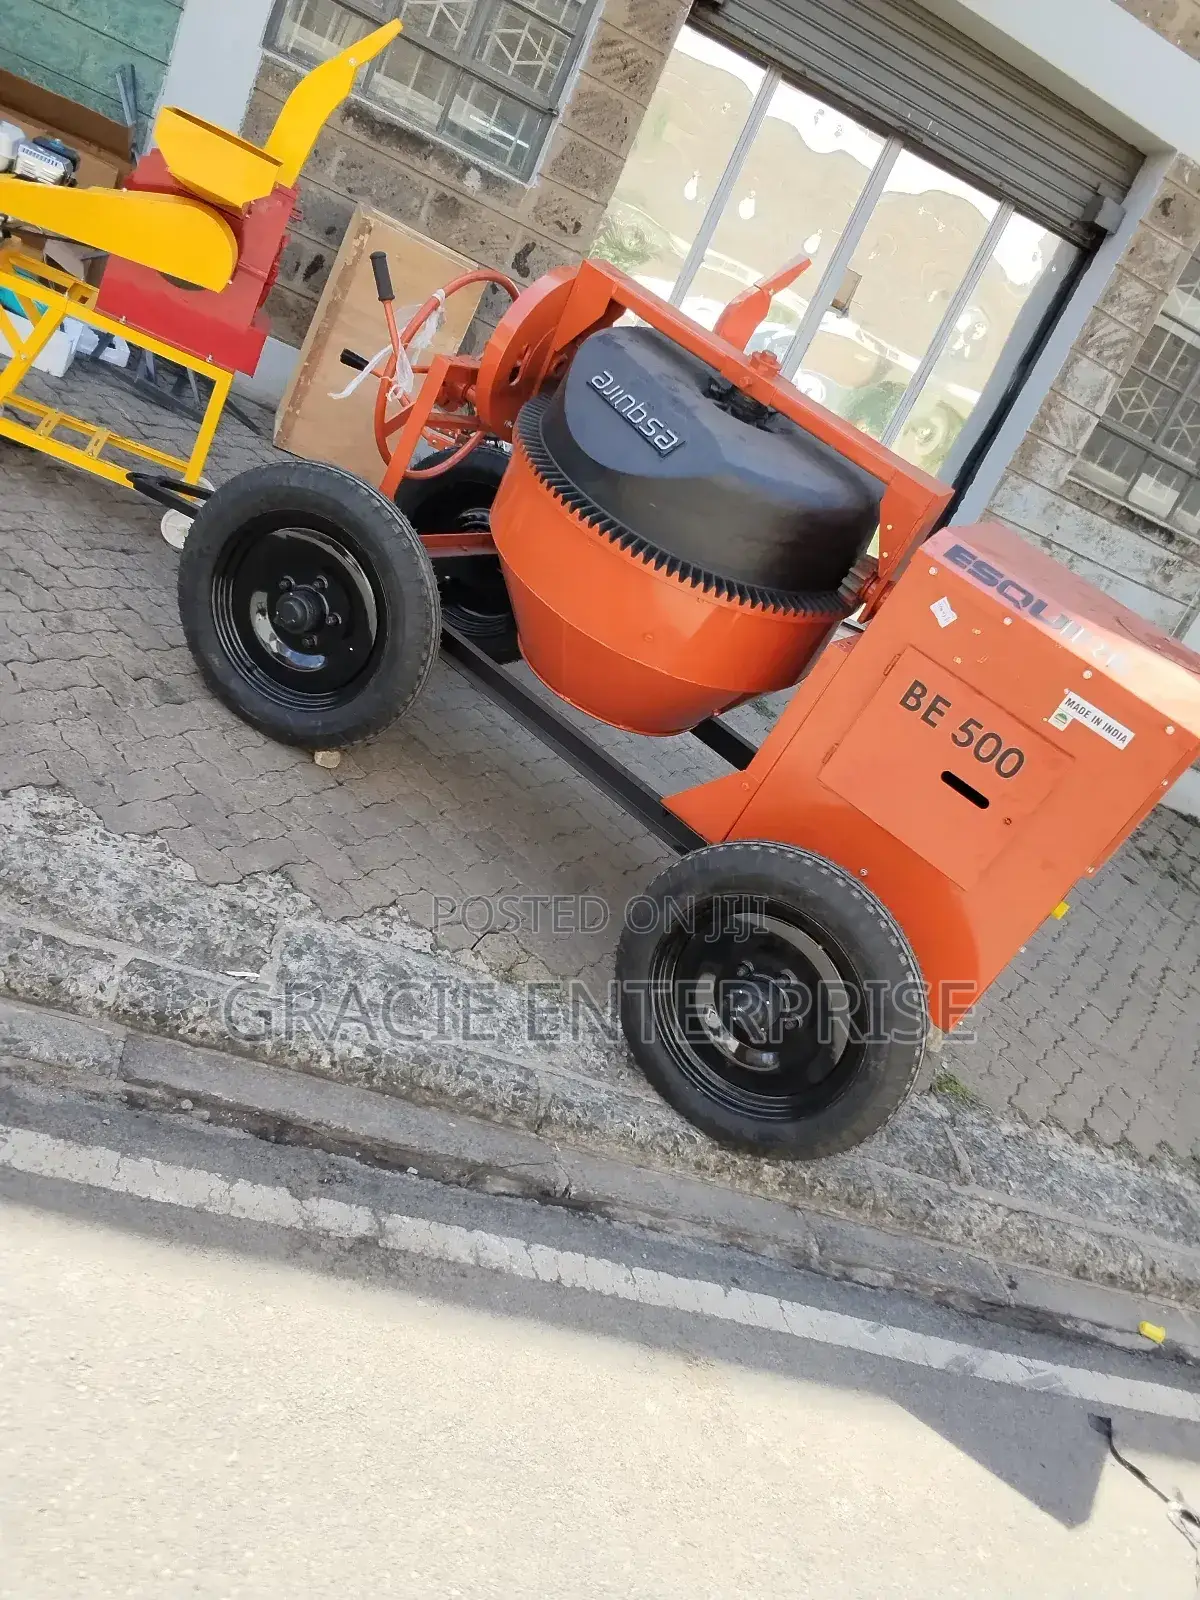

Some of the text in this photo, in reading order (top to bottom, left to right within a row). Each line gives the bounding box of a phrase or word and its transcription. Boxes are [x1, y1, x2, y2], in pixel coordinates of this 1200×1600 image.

[591, 370, 679, 450] esquire
[943, 544, 1129, 676] ESQUI
[898, 679, 1025, 780] BE 500
[1064, 697, 1128, 744] MADE IN INDIA
